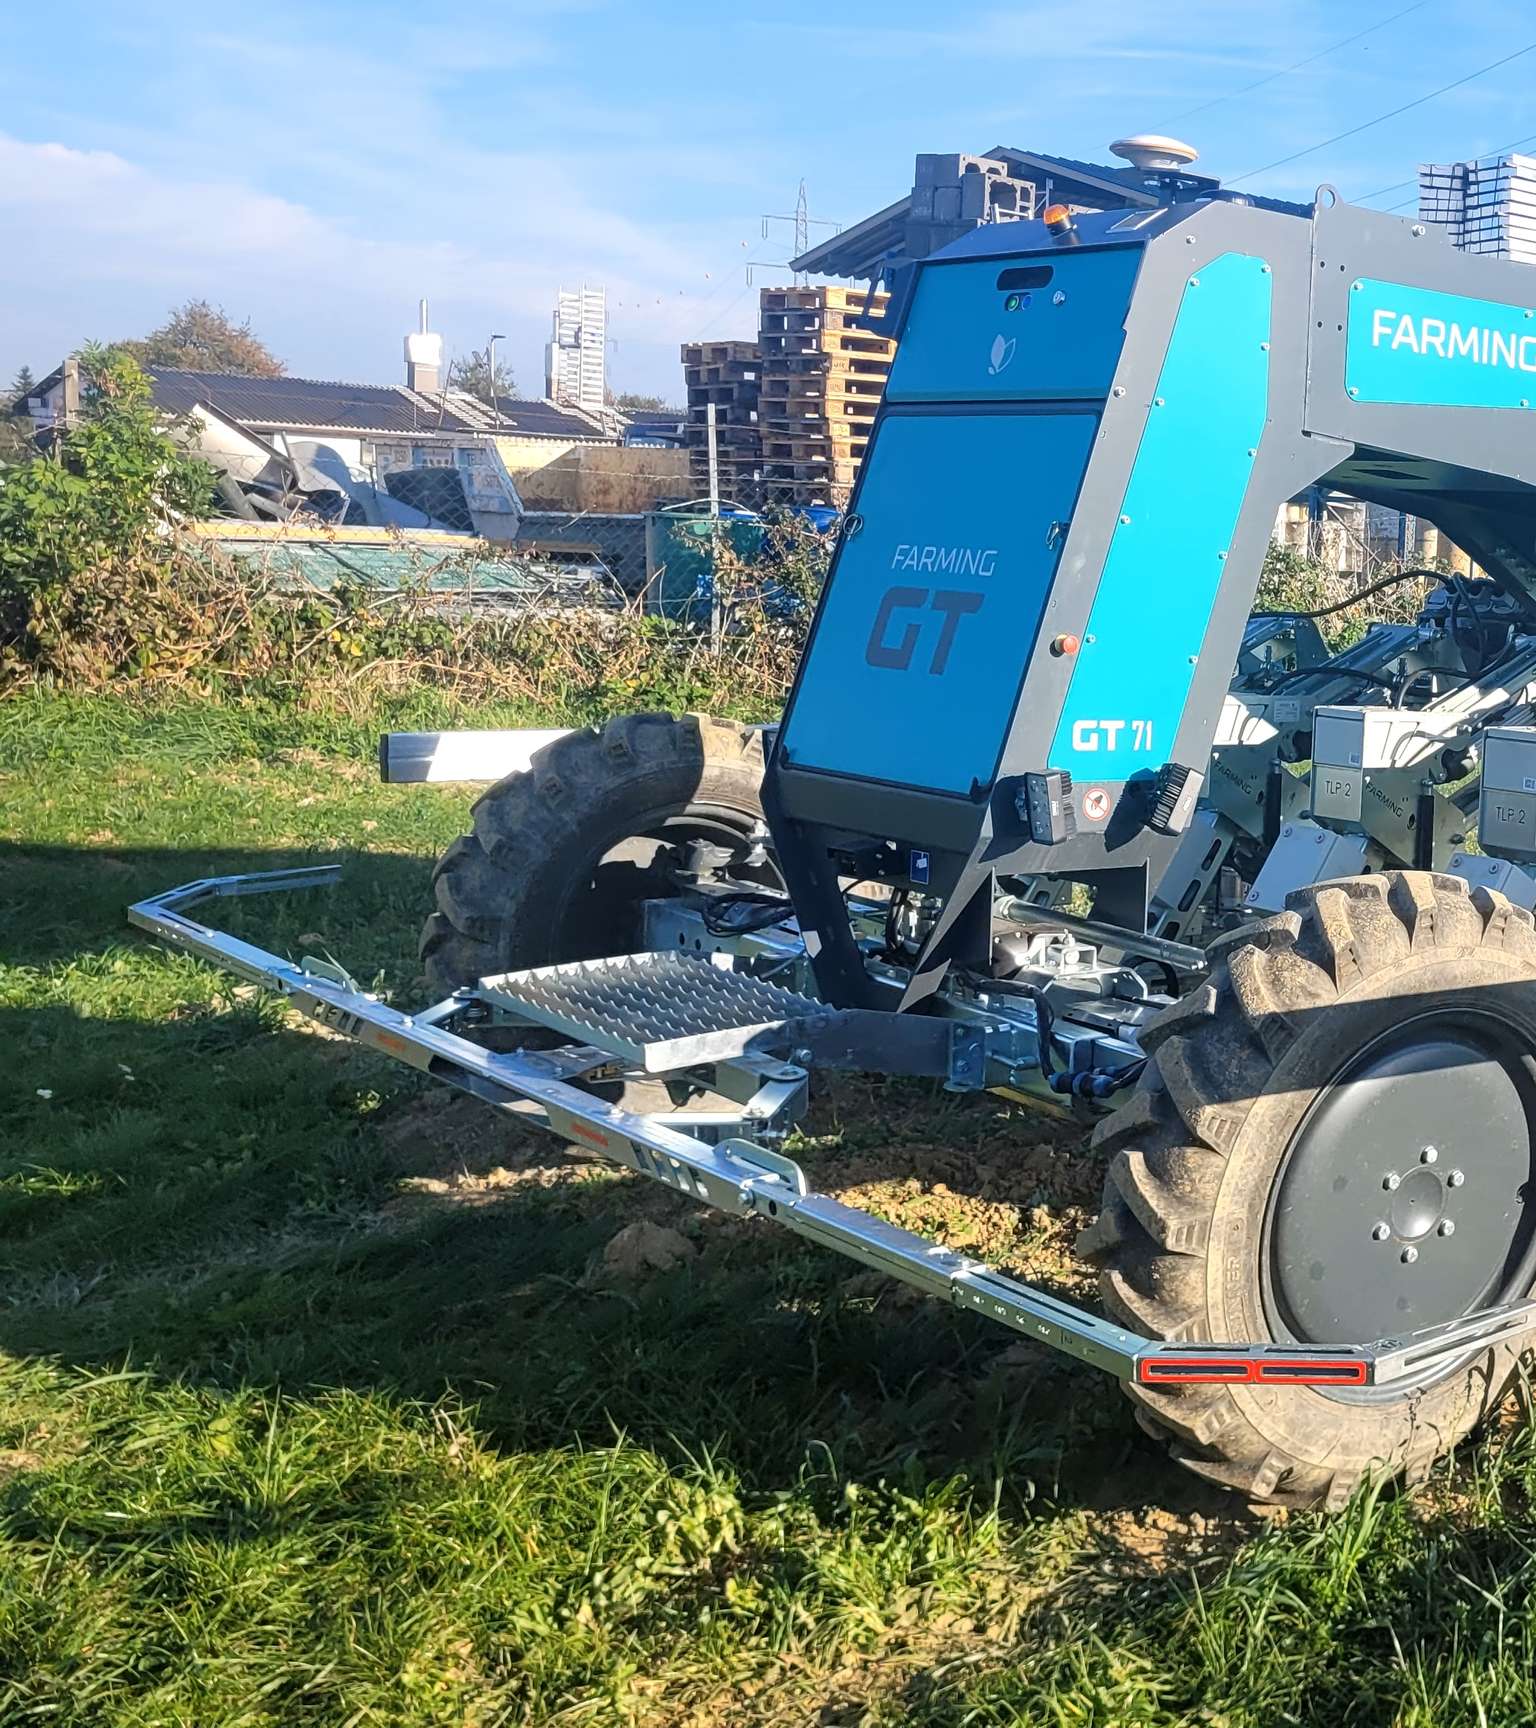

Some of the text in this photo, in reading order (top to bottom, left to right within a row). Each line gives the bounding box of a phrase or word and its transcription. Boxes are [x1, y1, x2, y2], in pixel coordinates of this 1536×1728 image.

[891, 544, 999, 577] FARMING
[865, 586, 986, 676] GT
[1072, 719, 1153, 752] GT 71
[1214, 760, 1252, 795] FARMING
[1325, 780, 1352, 797] TLP 2
[1366, 782, 1404, 818] FARMING
[1496, 806, 1526, 824] TLP 2
